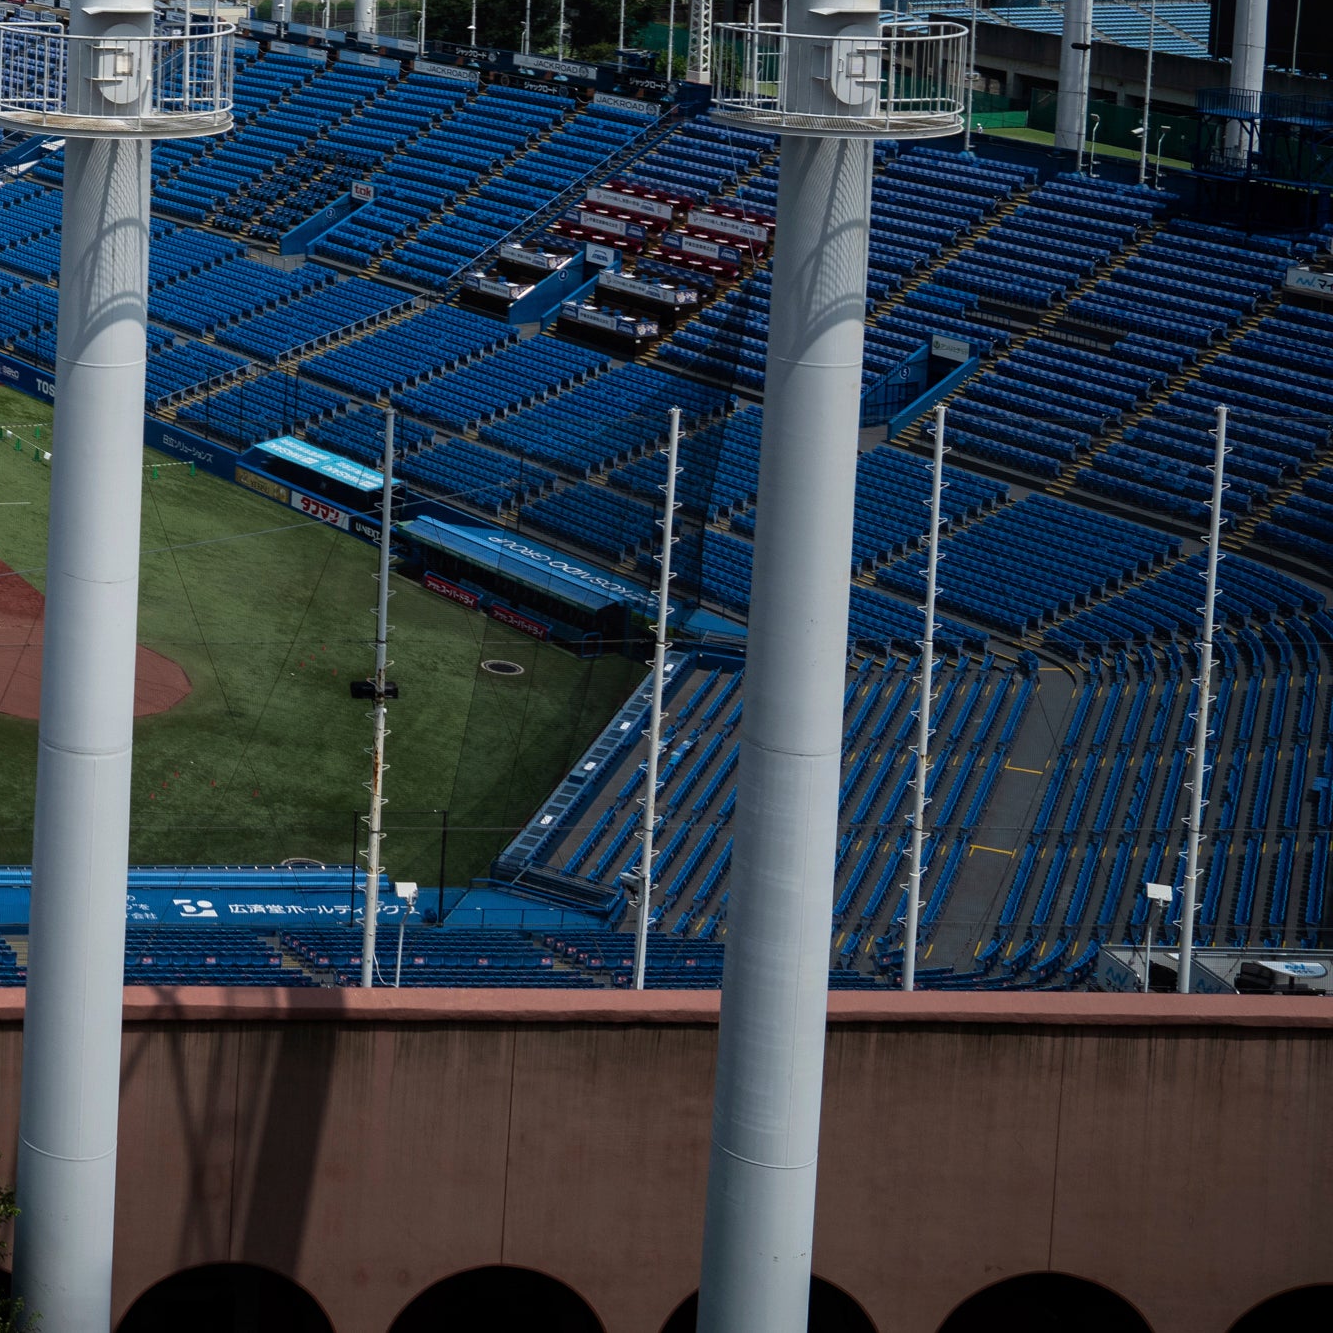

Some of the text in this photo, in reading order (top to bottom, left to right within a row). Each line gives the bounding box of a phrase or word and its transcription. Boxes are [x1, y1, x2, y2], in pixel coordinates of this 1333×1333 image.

[426, 65, 470, 80] JACKROAD
[534, 59, 578, 74] JACKROAD
[595, 93, 645, 112] JACKROAD
[901, 368, 908, 377] 5
[162, 434, 214, 464] 日立ソリューションズ
[300, 496, 341, 524] タフマン
[488, 536, 631, 598] KOSAIDO GROUP
